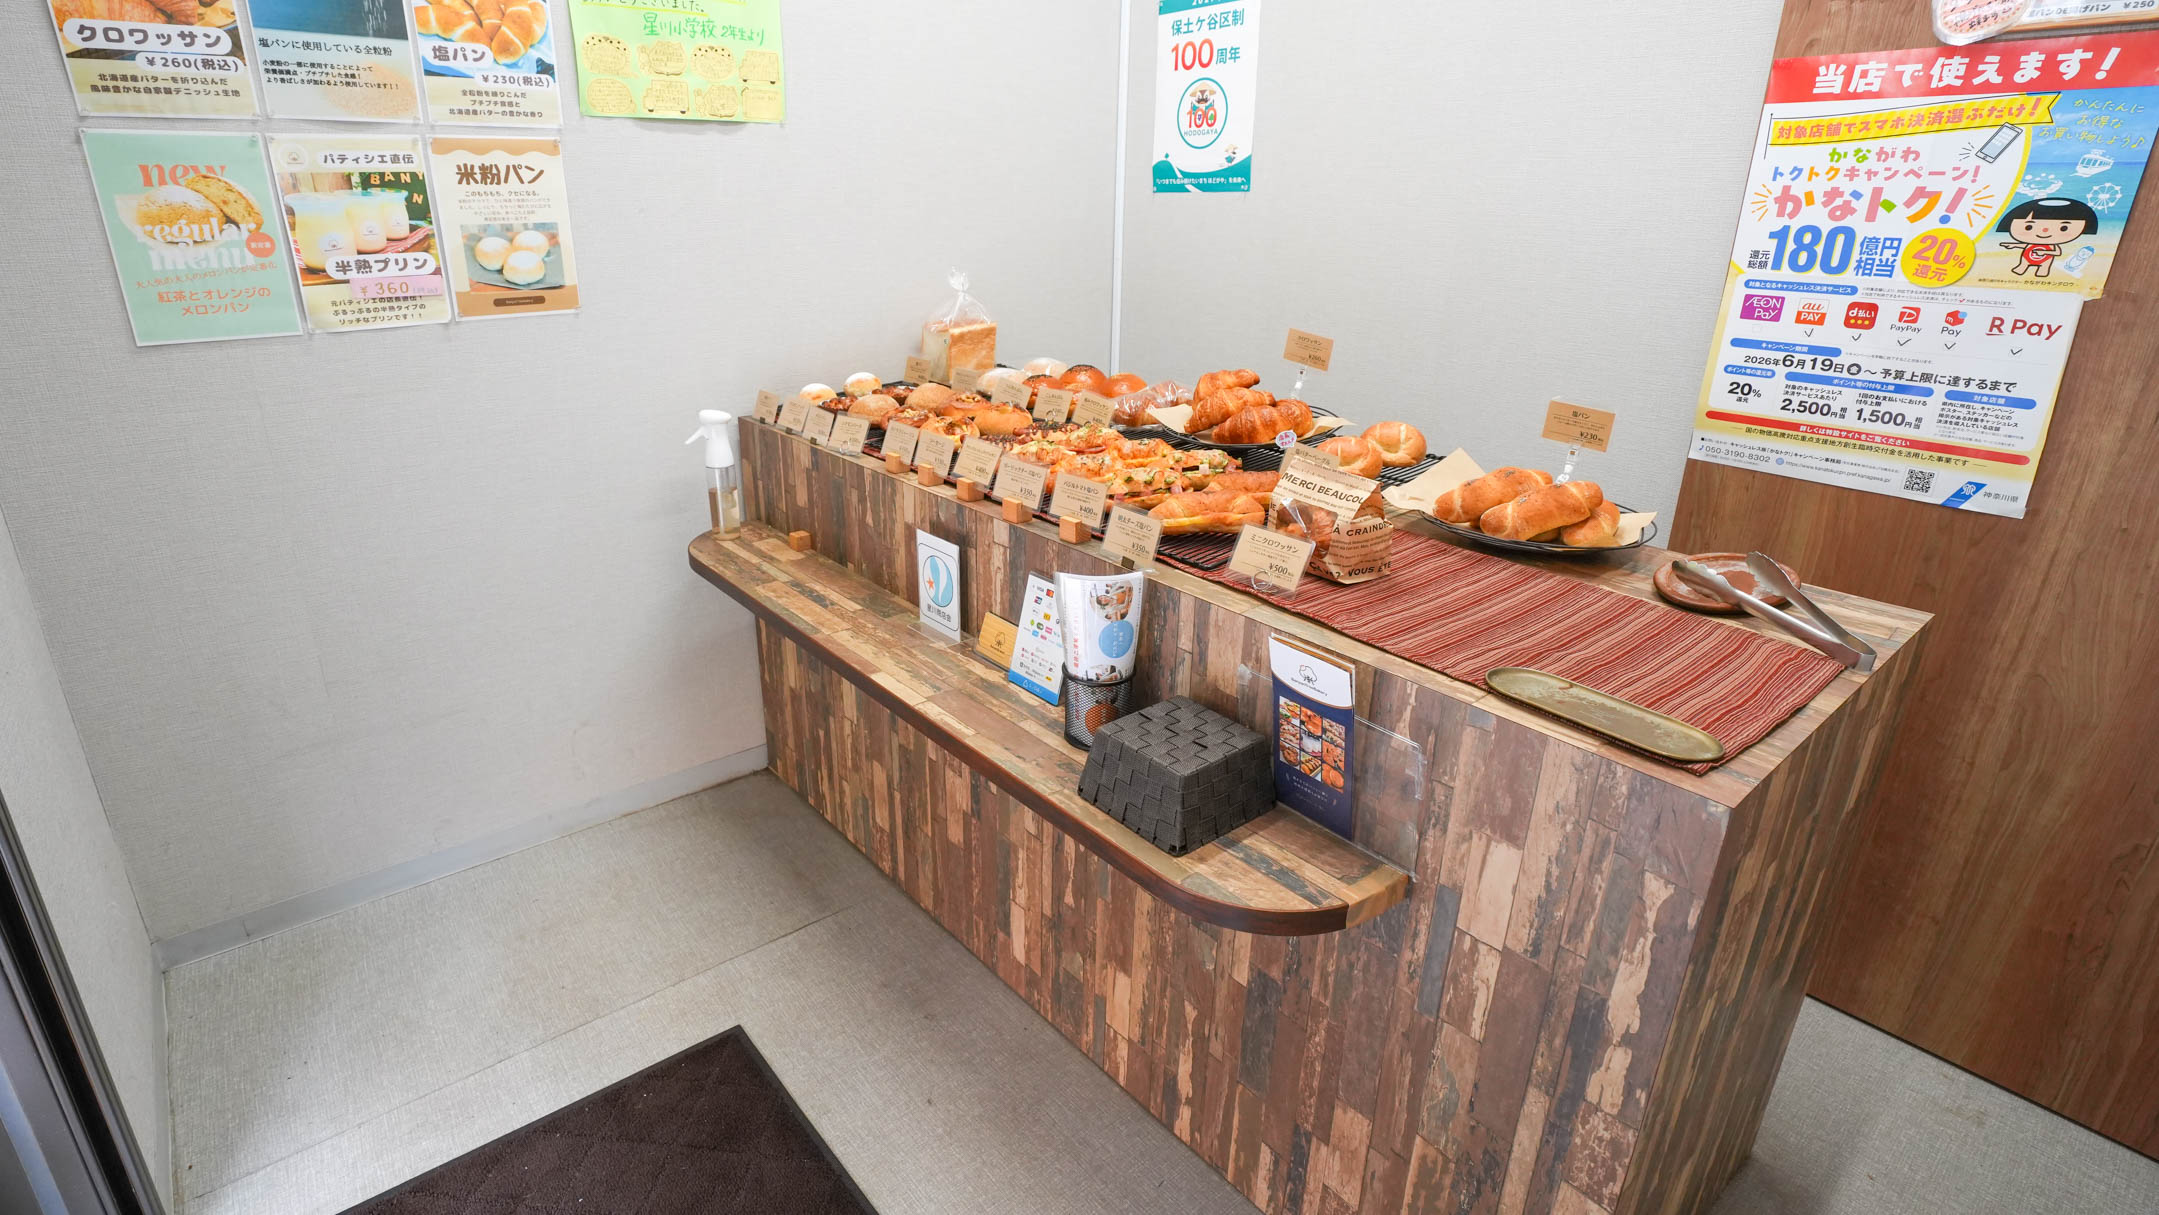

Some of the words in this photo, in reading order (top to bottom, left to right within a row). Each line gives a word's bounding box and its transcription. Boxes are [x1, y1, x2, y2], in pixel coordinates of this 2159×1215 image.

[77, 24, 222, 49] クロワッサン
[643, 12, 717, 38] 星川小学校
[720, 24, 765, 48] 2年生より
[258, 37, 393, 57] 塩パンに使用している全粒粉
[432, 45, 486, 62] 塩パン
[145, 55, 240, 74] ¥260(税込)
[1813, 47, 2122, 94] 当店で使えます!
[98, 74, 229, 88] 北海道産バターを折り込んだ
[482, 74, 550, 88] ¥230(税込)
[470, 99, 521, 108] プチプチ食感と
[2073, 99, 2146, 114] かんたんに
[449, 108, 543, 119] 北海道産バターの豊かな香り
[1186, 106, 1217, 129] 100
[1777, 97, 2042, 140] 対象店舗でスマホ決済選ぶだけ!
[2077, 115, 2125, 127] お得な
[1183, 128, 1218, 137] HODOGAYA
[323, 152, 416, 166] パティシエ直伝
[1828, 147, 1921, 164] かながわ
[455, 162, 545, 186] 米粉パン
[1772, 165, 1980, 184] トクトクキャンペーン!
[1773, 185, 1969, 225] かなトク!
[138, 217, 257, 248] regular
[1767, 224, 1857, 275] 180
[1859, 236, 1903, 257] 億円
[148, 247, 257, 272] menu
[1749, 249, 1771, 260] 還元
[335, 257, 429, 276] 半熟プリン
[1747, 260, 1769, 270] 総額
[1854, 257, 1898, 279] 相当
[1912, 263, 1949, 282] 還元
[1748, 280, 1852, 294] 対象となるキャッシュレス決済サービス
[157, 287, 272, 303] 紅茶とオレンジの
[182, 301, 250, 317] メロンパン
[1802, 302, 1824, 311] au
[1848, 307, 1874, 318] d払い
[1754, 309, 1778, 320] Pay
[1800, 313, 1821, 321] PAY
[1889, 323, 1923, 334] PayPay
[1941, 327, 1962, 338] Pay
[2009, 318, 2063, 341] Pay
[1761, 342, 1809, 353] キャンペーン期間
[1727, 381, 1762, 398] 20%
[1784, 384, 1843, 396] 対象のキャッシュレス
[1832, 379, 1896, 391] ポイント等の付与上限
[1782, 391, 1838, 402] 決済サービスあたり
[1855, 399, 1882, 407] 付与上限
[1857, 392, 1928, 407] 1回のお支払いにおける
[1973, 395, 2006, 405] 対象店舗
[1572, 410, 1591, 420] 塩パン
[1579, 430, 1598, 441] ¥230
[1799, 426, 1910, 447] 詳しくは特設サイトをご覧ください
[1705, 445, 1771, 463] 050-3190-8302
[1281, 472, 1318, 493] MERCI
[1983, 491, 2019, 503] 神奈川県
[1249, 532, 1300, 554] ミニクロワッサン
[1268, 562, 1289, 576] ¥500
[1348, 566, 1375, 577] VOUS
